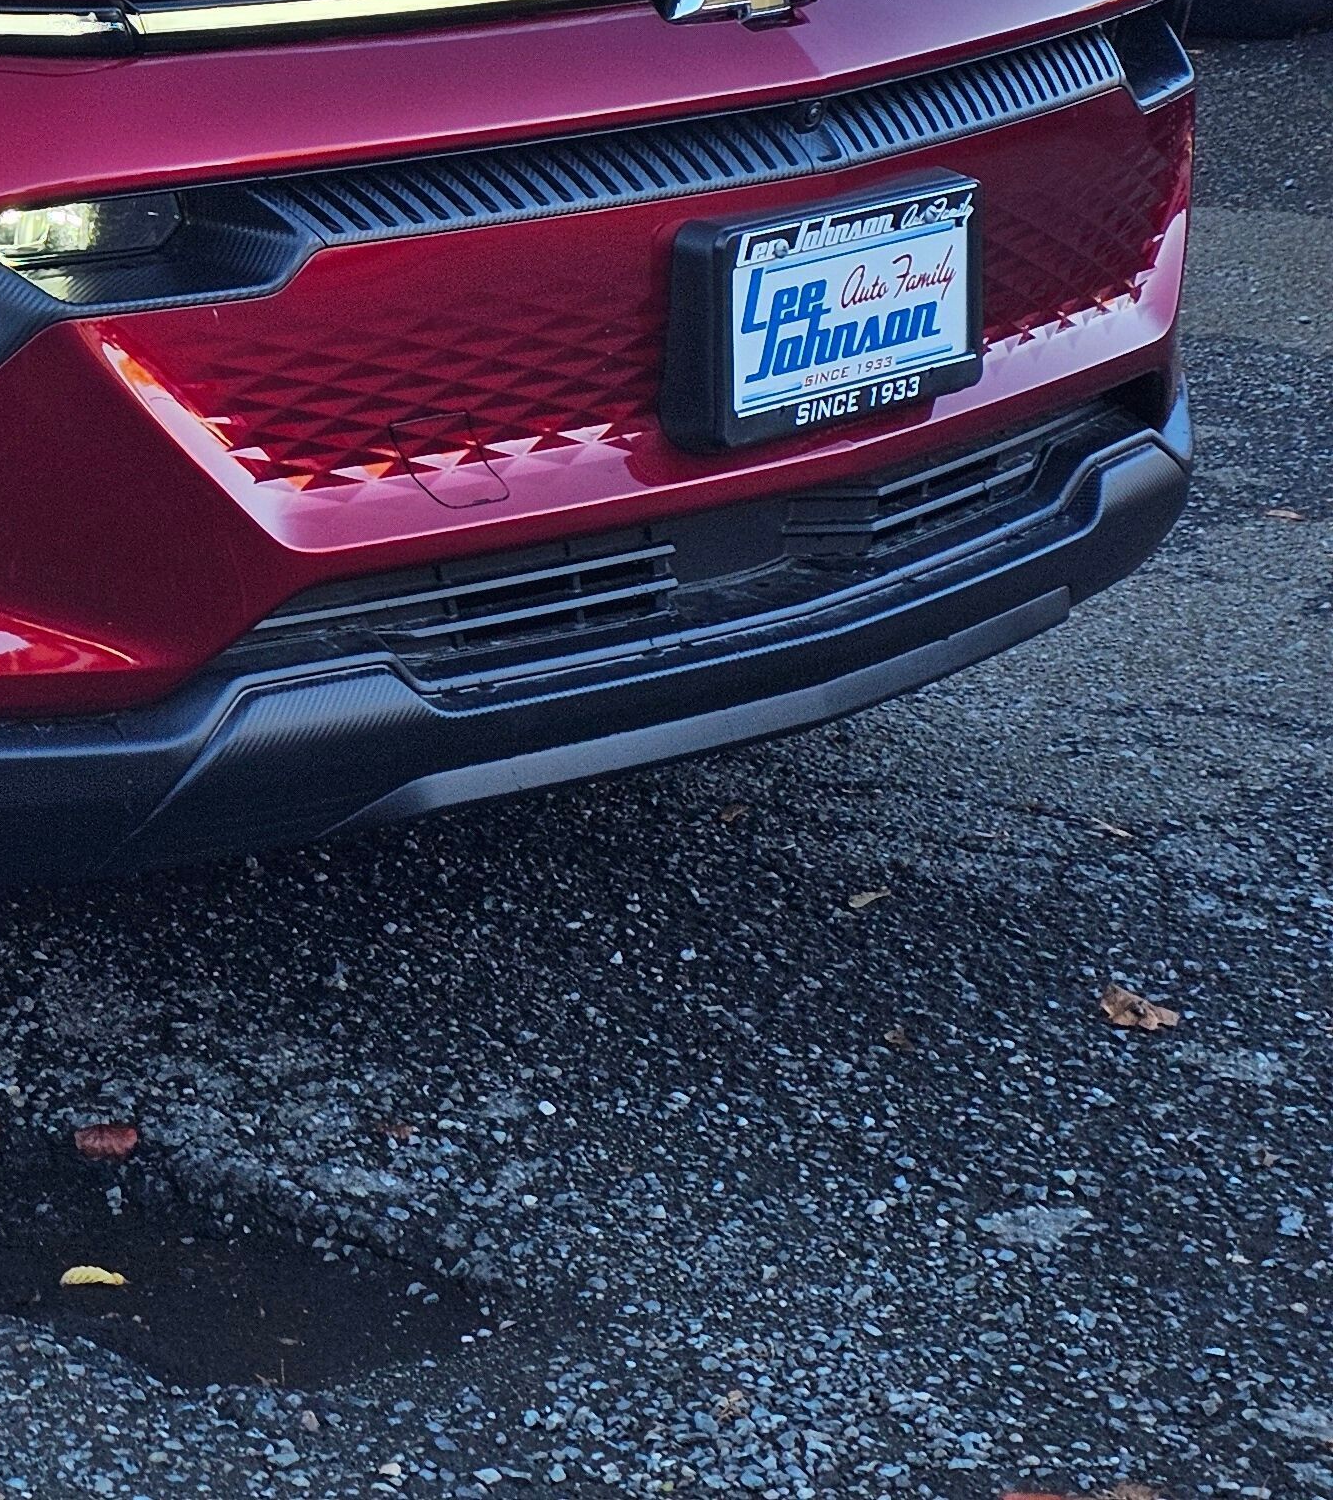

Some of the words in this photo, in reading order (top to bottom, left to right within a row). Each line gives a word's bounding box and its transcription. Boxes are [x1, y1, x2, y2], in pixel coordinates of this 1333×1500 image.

[789, 213, 895, 256] Johnson
[740, 267, 829, 335] Lee
[841, 264, 889, 310] Auto
[891, 244, 956, 300] Family
[744, 298, 941, 384] Johnson
[804, 365, 850, 387] SINCE
[856, 356, 893, 376] 1933
[795, 394, 860, 425] SINCE
[869, 376, 921, 407] 1933
